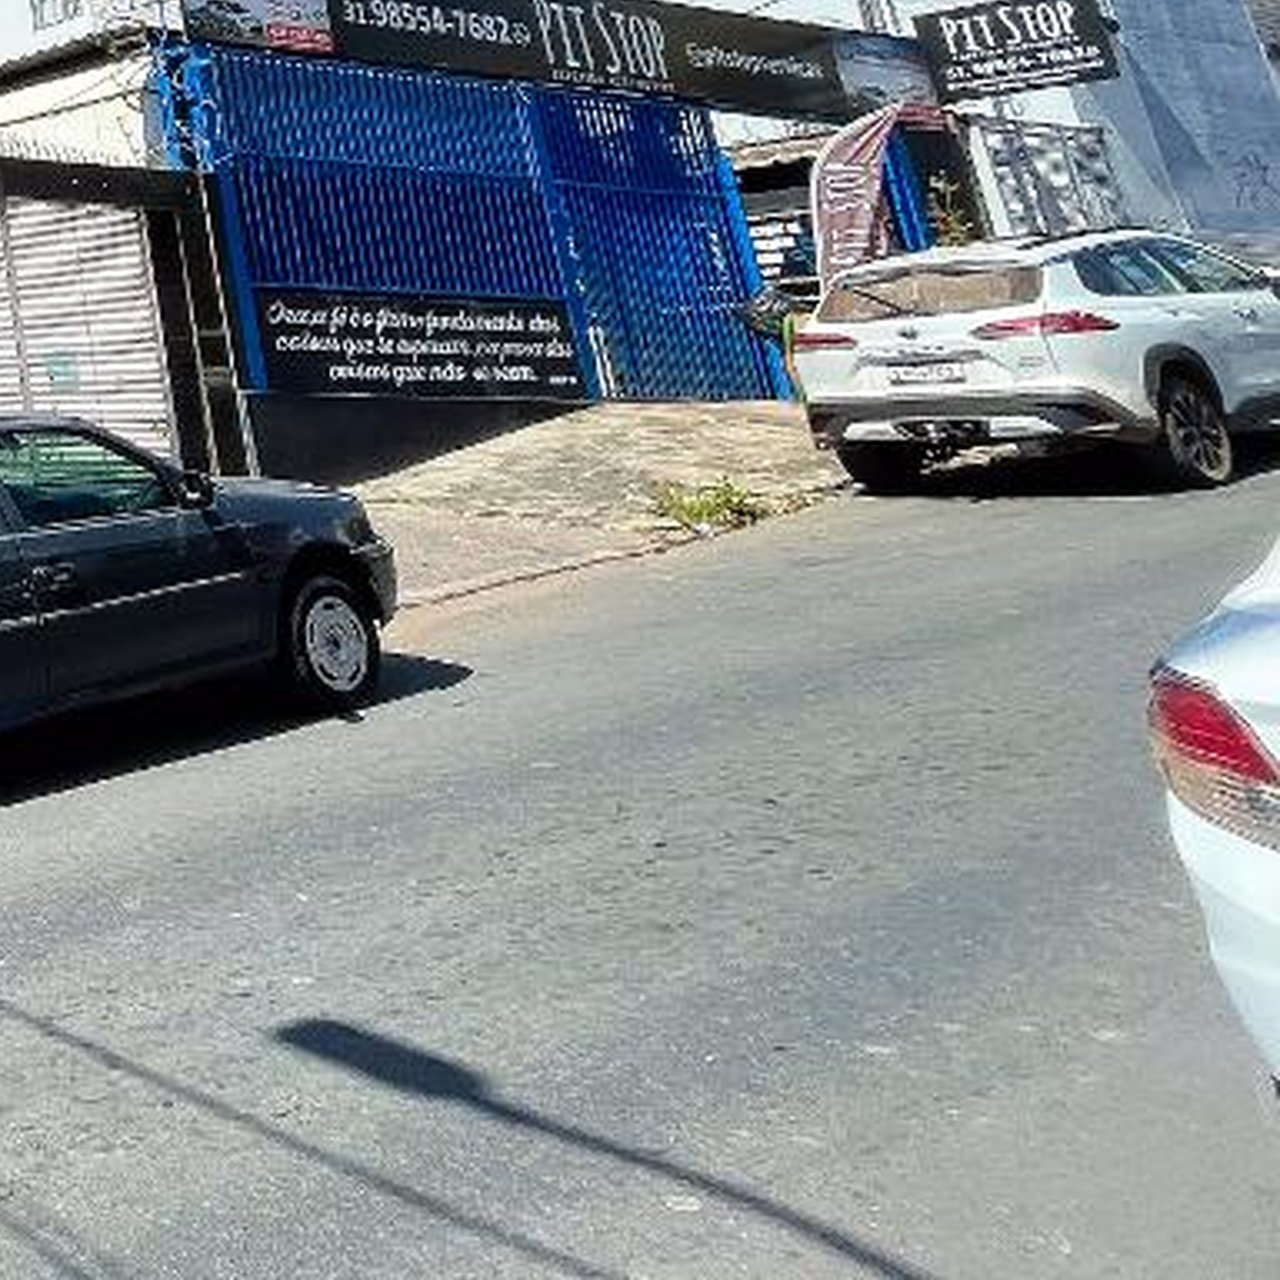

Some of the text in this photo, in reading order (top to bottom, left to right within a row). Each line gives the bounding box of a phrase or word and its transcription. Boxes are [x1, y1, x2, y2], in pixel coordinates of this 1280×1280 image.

[593, 2, 669, 80] STOP
[939, 15, 996, 54] PIT
[997, 0, 1075, 45] STOP
